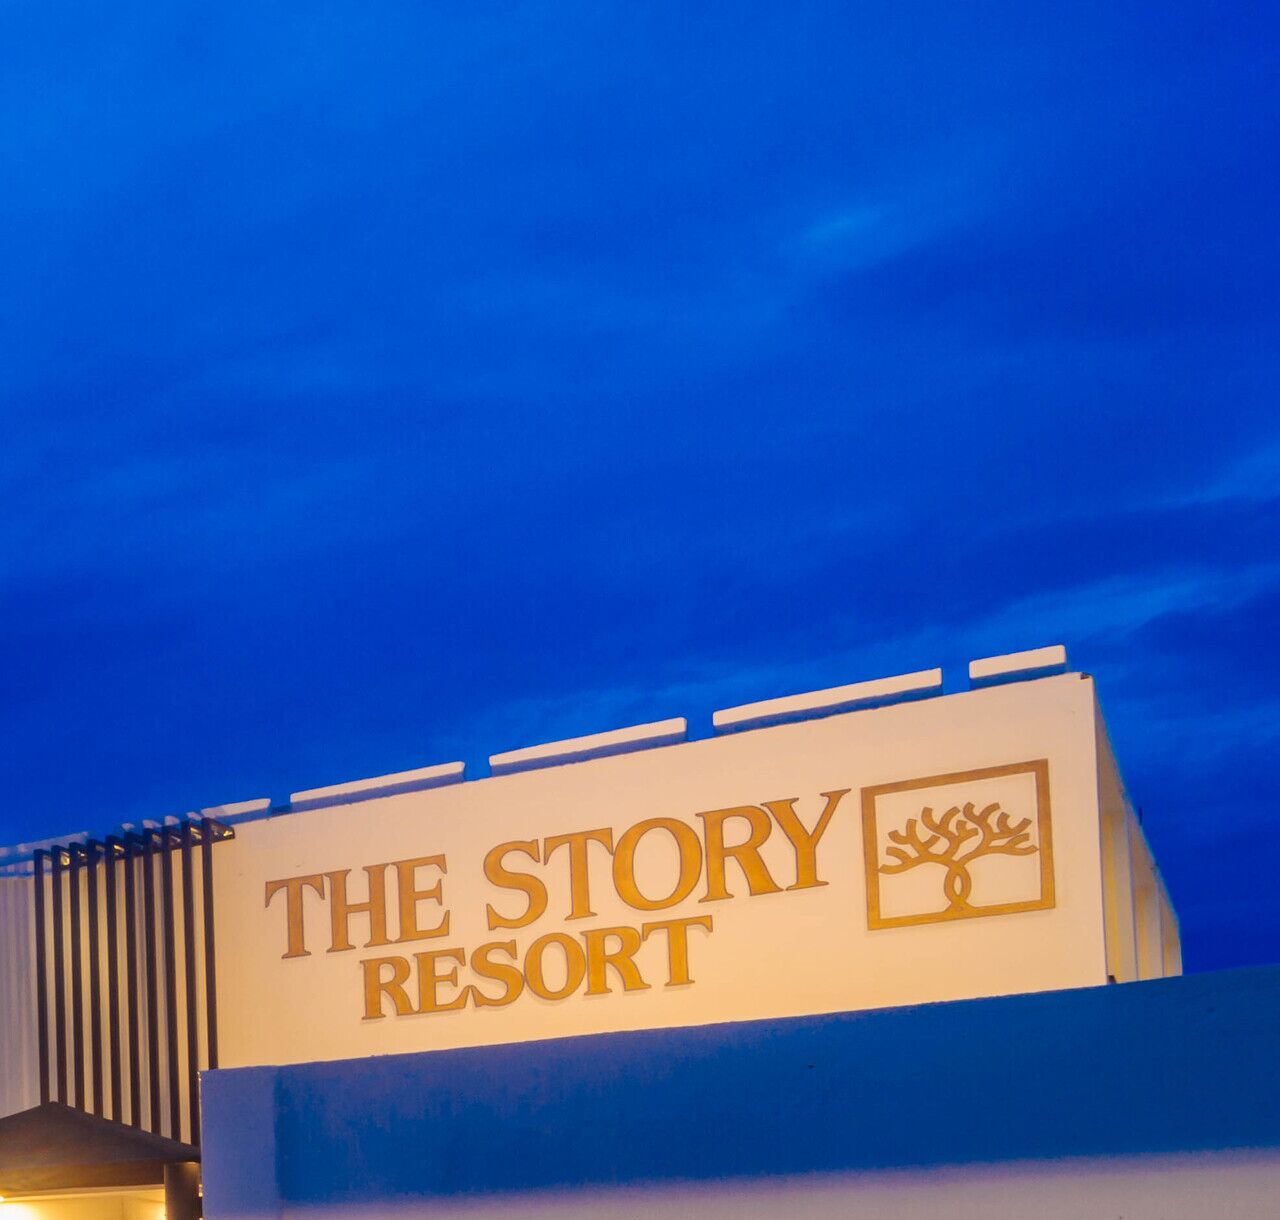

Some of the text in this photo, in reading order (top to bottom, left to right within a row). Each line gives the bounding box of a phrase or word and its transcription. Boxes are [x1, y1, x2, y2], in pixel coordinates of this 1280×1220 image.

[265, 788, 852, 960] THE STORY
[359, 914, 714, 1022] RESORT
